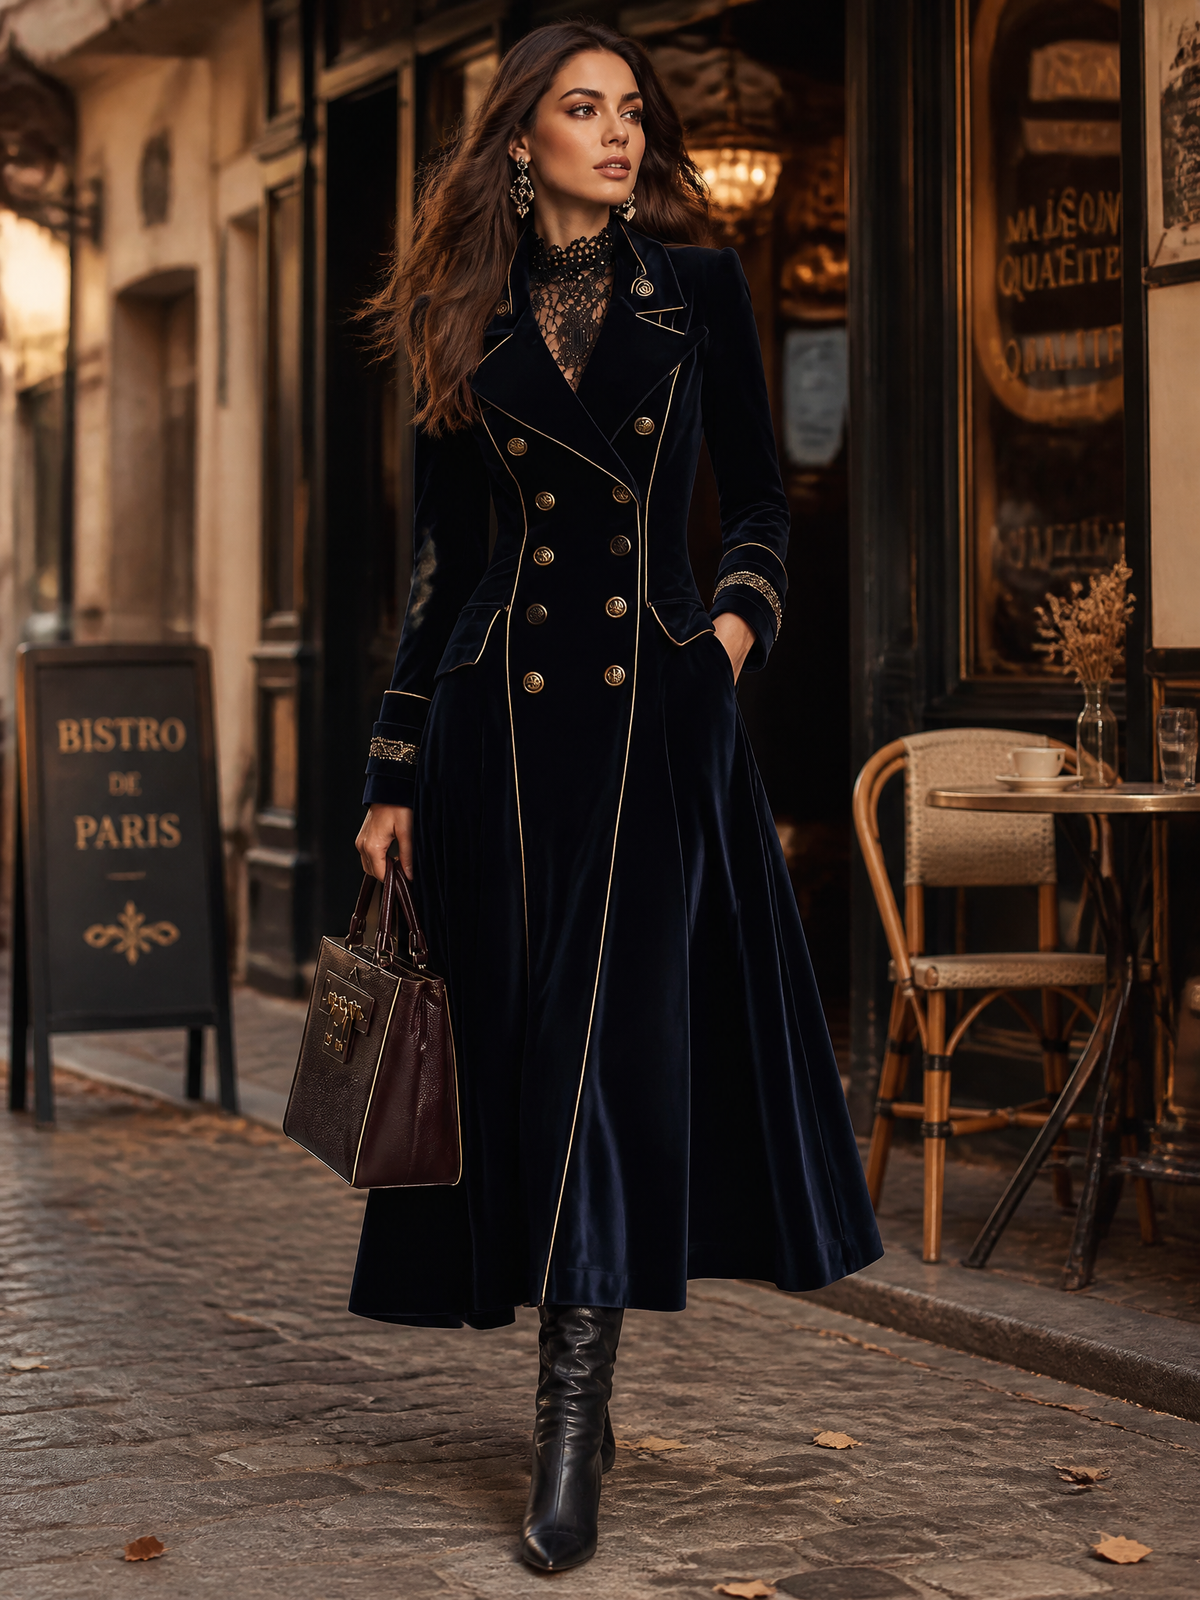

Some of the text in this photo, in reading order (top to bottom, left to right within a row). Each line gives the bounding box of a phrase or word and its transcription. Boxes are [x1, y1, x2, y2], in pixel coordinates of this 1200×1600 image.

[57, 717, 187, 753] BISTRO
[108, 771, 142, 797] DE
[74, 813, 182, 850] PARIS
